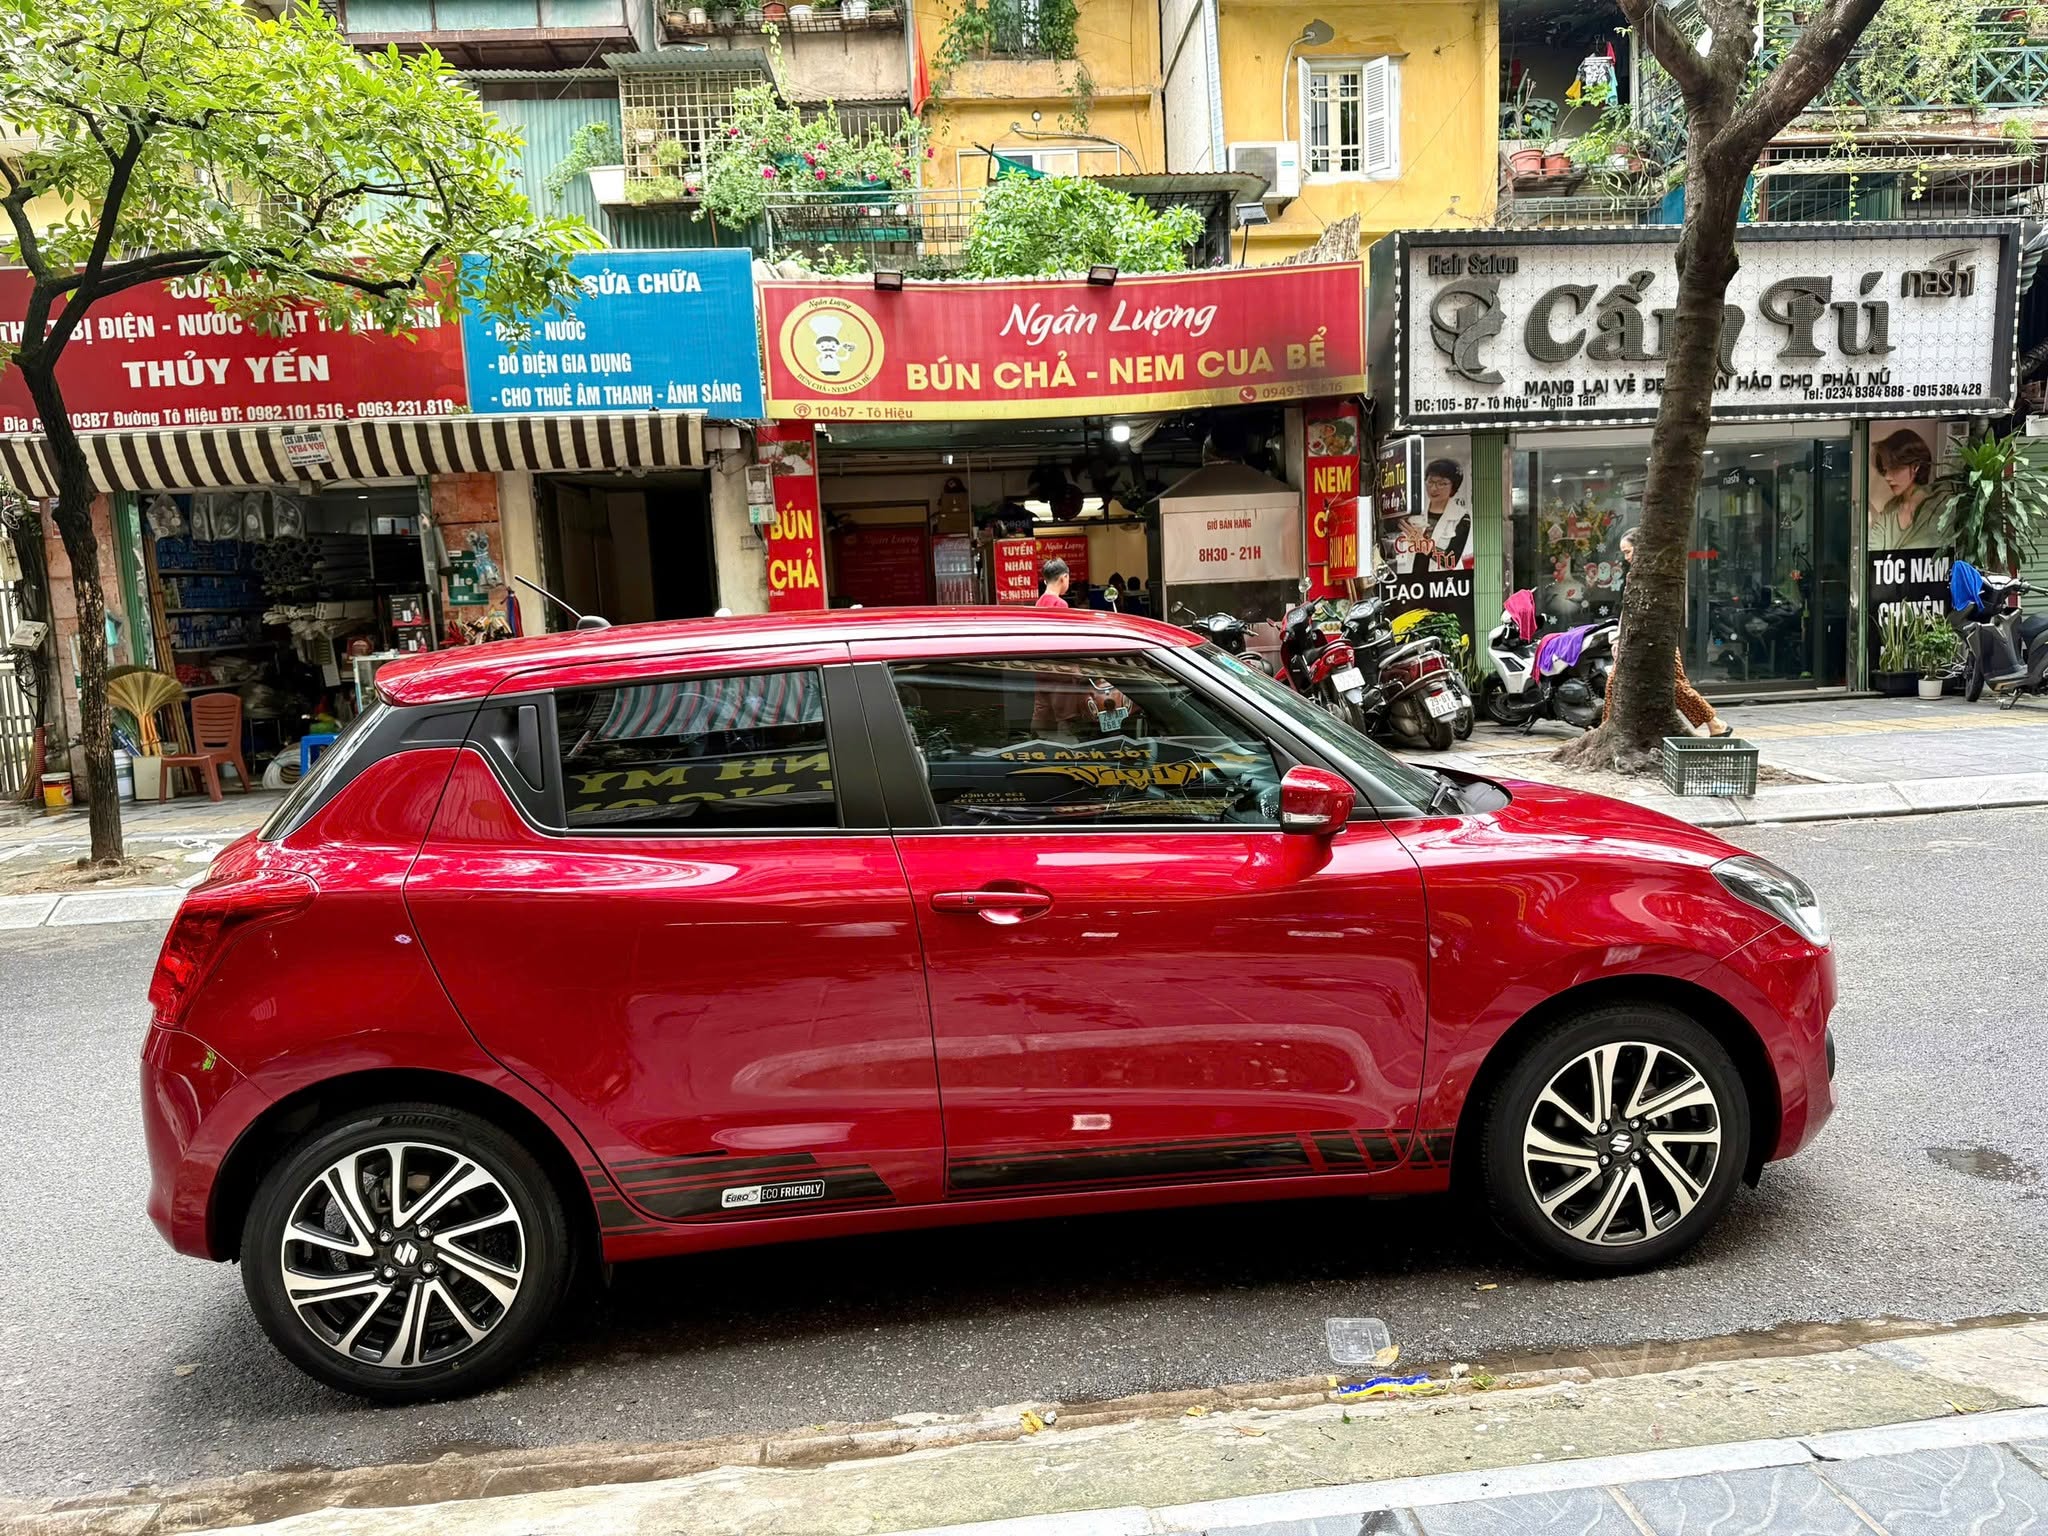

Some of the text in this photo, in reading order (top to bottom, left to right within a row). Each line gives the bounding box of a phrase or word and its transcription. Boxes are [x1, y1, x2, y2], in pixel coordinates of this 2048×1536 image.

[1429, 254, 1519, 275] Hair Salon
[1901, 259, 1977, 298] nashi
[638, 268, 702, 293] CHỮA
[98, 311, 155, 343] ĐIỆN
[1000, 299, 1217, 346] Ngân Lượng
[122, 347, 330, 388] THỦY YẾN
[522, 350, 558, 378] ĐIỆN
[561, 354, 587, 374] GIA
[590, 352, 632, 378] DỤNG
[906, 354, 981, 391] BÚN
[992, 350, 1074, 390] CHẢ
[1108, 353, 1186, 385] NEM
[1196, 346, 1274, 377] CUA
[1286, 326, 1329, 370] BỂ
[501, 386, 532, 407] CHO
[535, 383, 572, 406] THUÊ
[576, 383, 600, 406] ÂM
[604, 384, 652, 405] THANH
[667, 380, 698, 403] ÁNH
[701, 380, 742, 403] SÁNG
[1524, 379, 1575, 396] MANG
[1780, 374, 1813, 388] CHO
[1822, 367, 1860, 387] PHÁI
[1803, 386, 1823, 400] Tel:
[113, 410, 160, 427] Đường
[162, 409, 181, 424] Tô
[184, 407, 218, 426] Hiệu
[221, 407, 244, 422] ĐT:
[247, 402, 344, 422] 0982.101.516
[357, 399, 454, 418] 0963.231.819
[815, 406, 855, 418] 104b7
[866, 407, 881, 418] Tô
[1488, 396, 1500, 409] Tô
[1503, 395, 1529, 412] Hiệu
[1314, 465, 1352, 494] NEM
[770, 501, 813, 540] BÚN
[1199, 547, 1228, 562] 8H30
[1239, 545, 1261, 560] 21H
[769, 548, 819, 589] CHẢ
[1874, 554, 1949, 585] TÓC NAM
[1385, 577, 1470, 604] TẠO MẪU
[1878, 595, 1945, 628] CHYÊN
[761, 1188, 779, 1200] ECO
[780, 1183, 821, 1198] FRIENDLY
